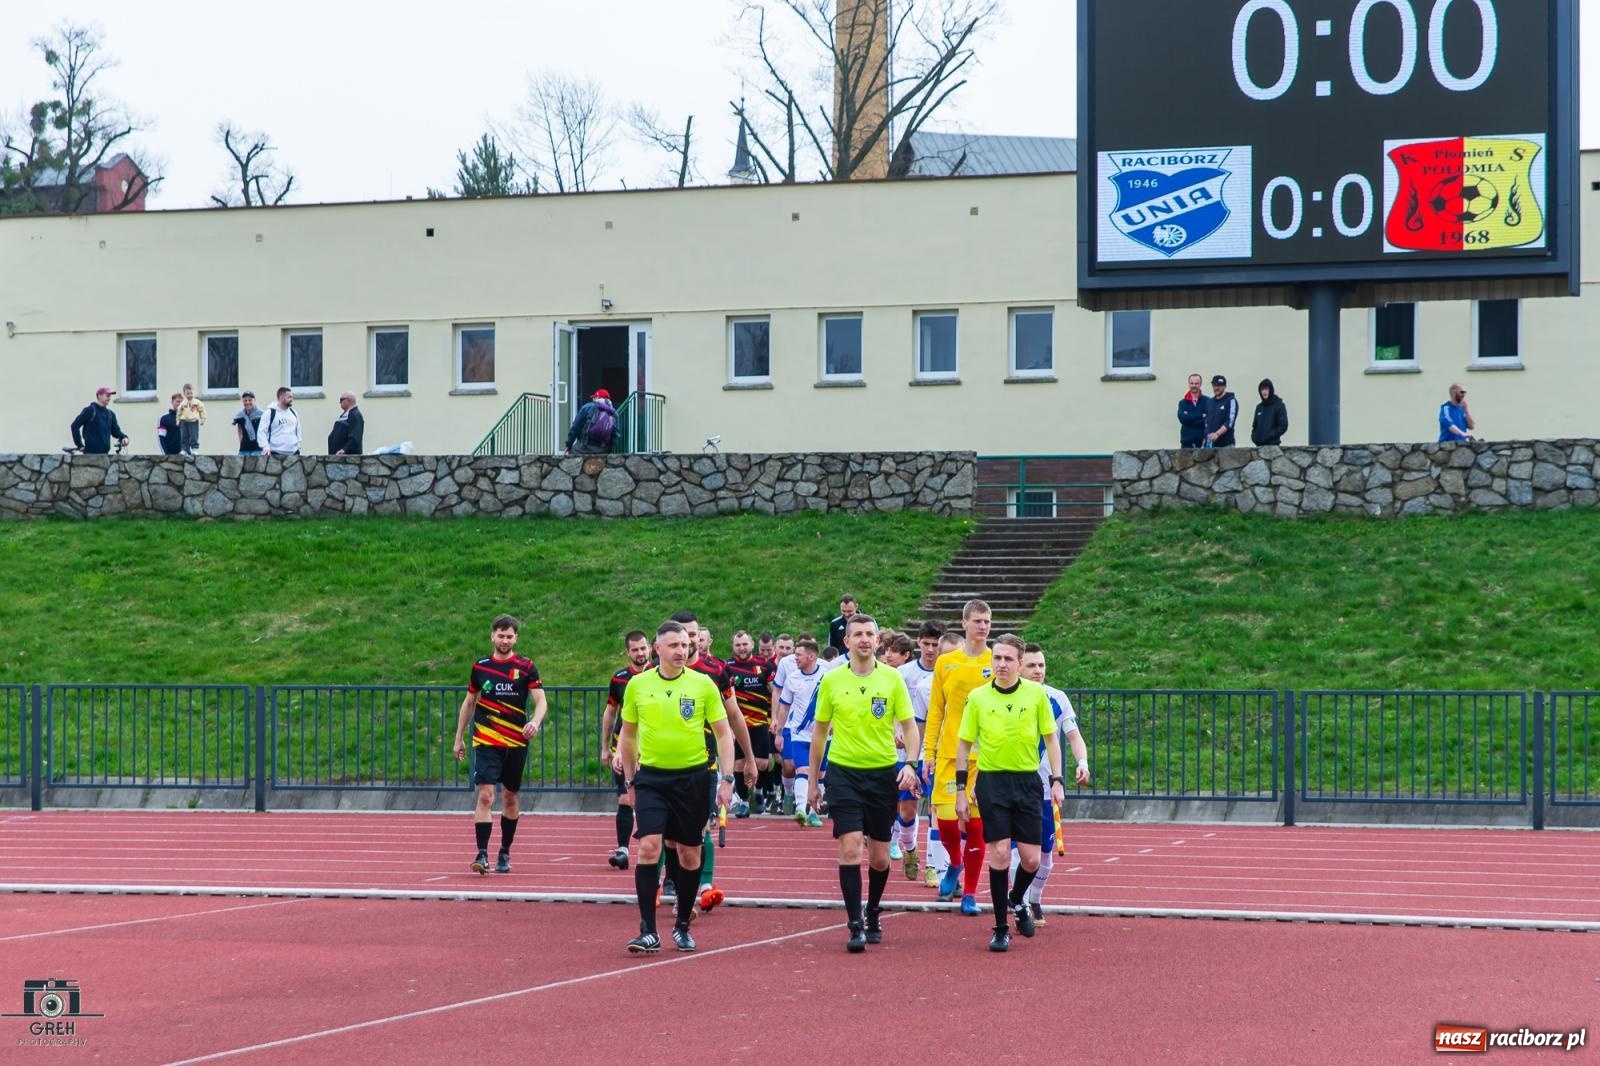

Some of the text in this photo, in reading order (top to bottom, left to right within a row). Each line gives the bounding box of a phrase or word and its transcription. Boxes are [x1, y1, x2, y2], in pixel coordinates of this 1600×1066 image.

[1231, 0, 1498, 100] 0:00
[1121, 152, 1218, 167] RACIBÓRZ
[1400, 153, 1419, 165] K
[1509, 147, 1526, 162] S
[1128, 178, 1159, 189] 1946
[1121, 186, 1213, 226] UNIA
[1261, 173, 1374, 239] 0:0
[1439, 229, 1490, 245] 1968
[495, 682, 513, 691] CUK
